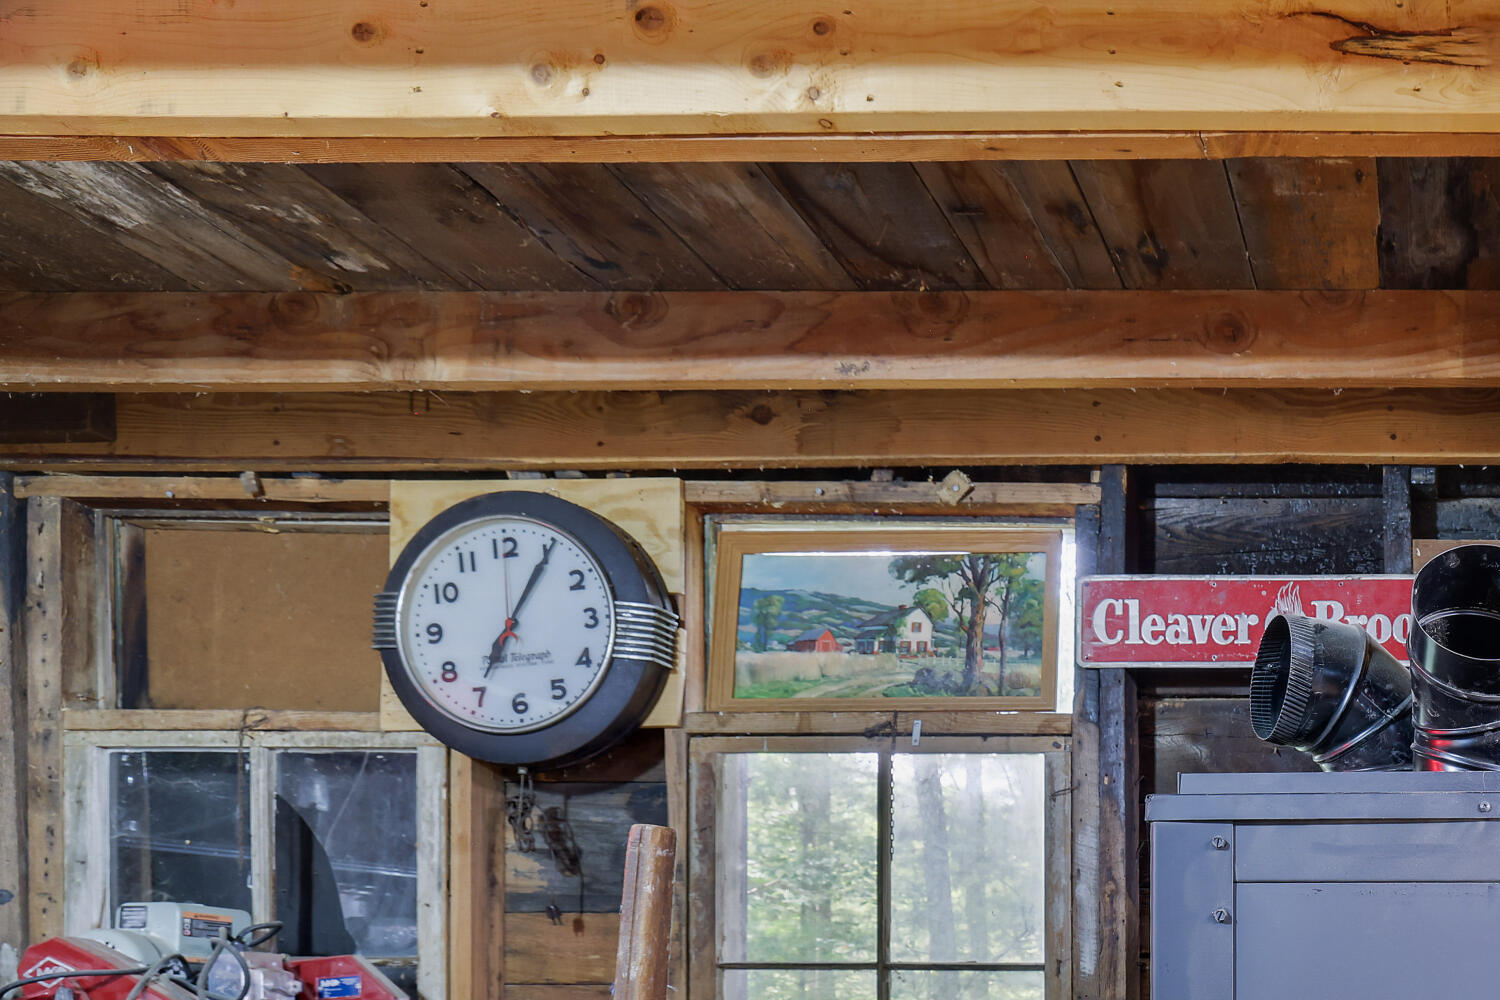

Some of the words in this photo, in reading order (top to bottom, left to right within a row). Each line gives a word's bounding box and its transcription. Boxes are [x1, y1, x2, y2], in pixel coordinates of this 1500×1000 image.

[491, 536, 519, 559] 12
[458, 551, 477, 573] 11
[569, 569, 586, 591] 2
[433, 582, 459, 605] 10
[583, 607, 600, 630] 3
[1092, 598, 1259, 646] Cleaver
[426, 622, 443, 645] 9
[575, 647, 593, 669] 4
[441, 660, 459, 684] 8
[472, 686, 488, 708] 7
[550, 679, 567, 701] 5
[511, 693, 529, 714] 6
